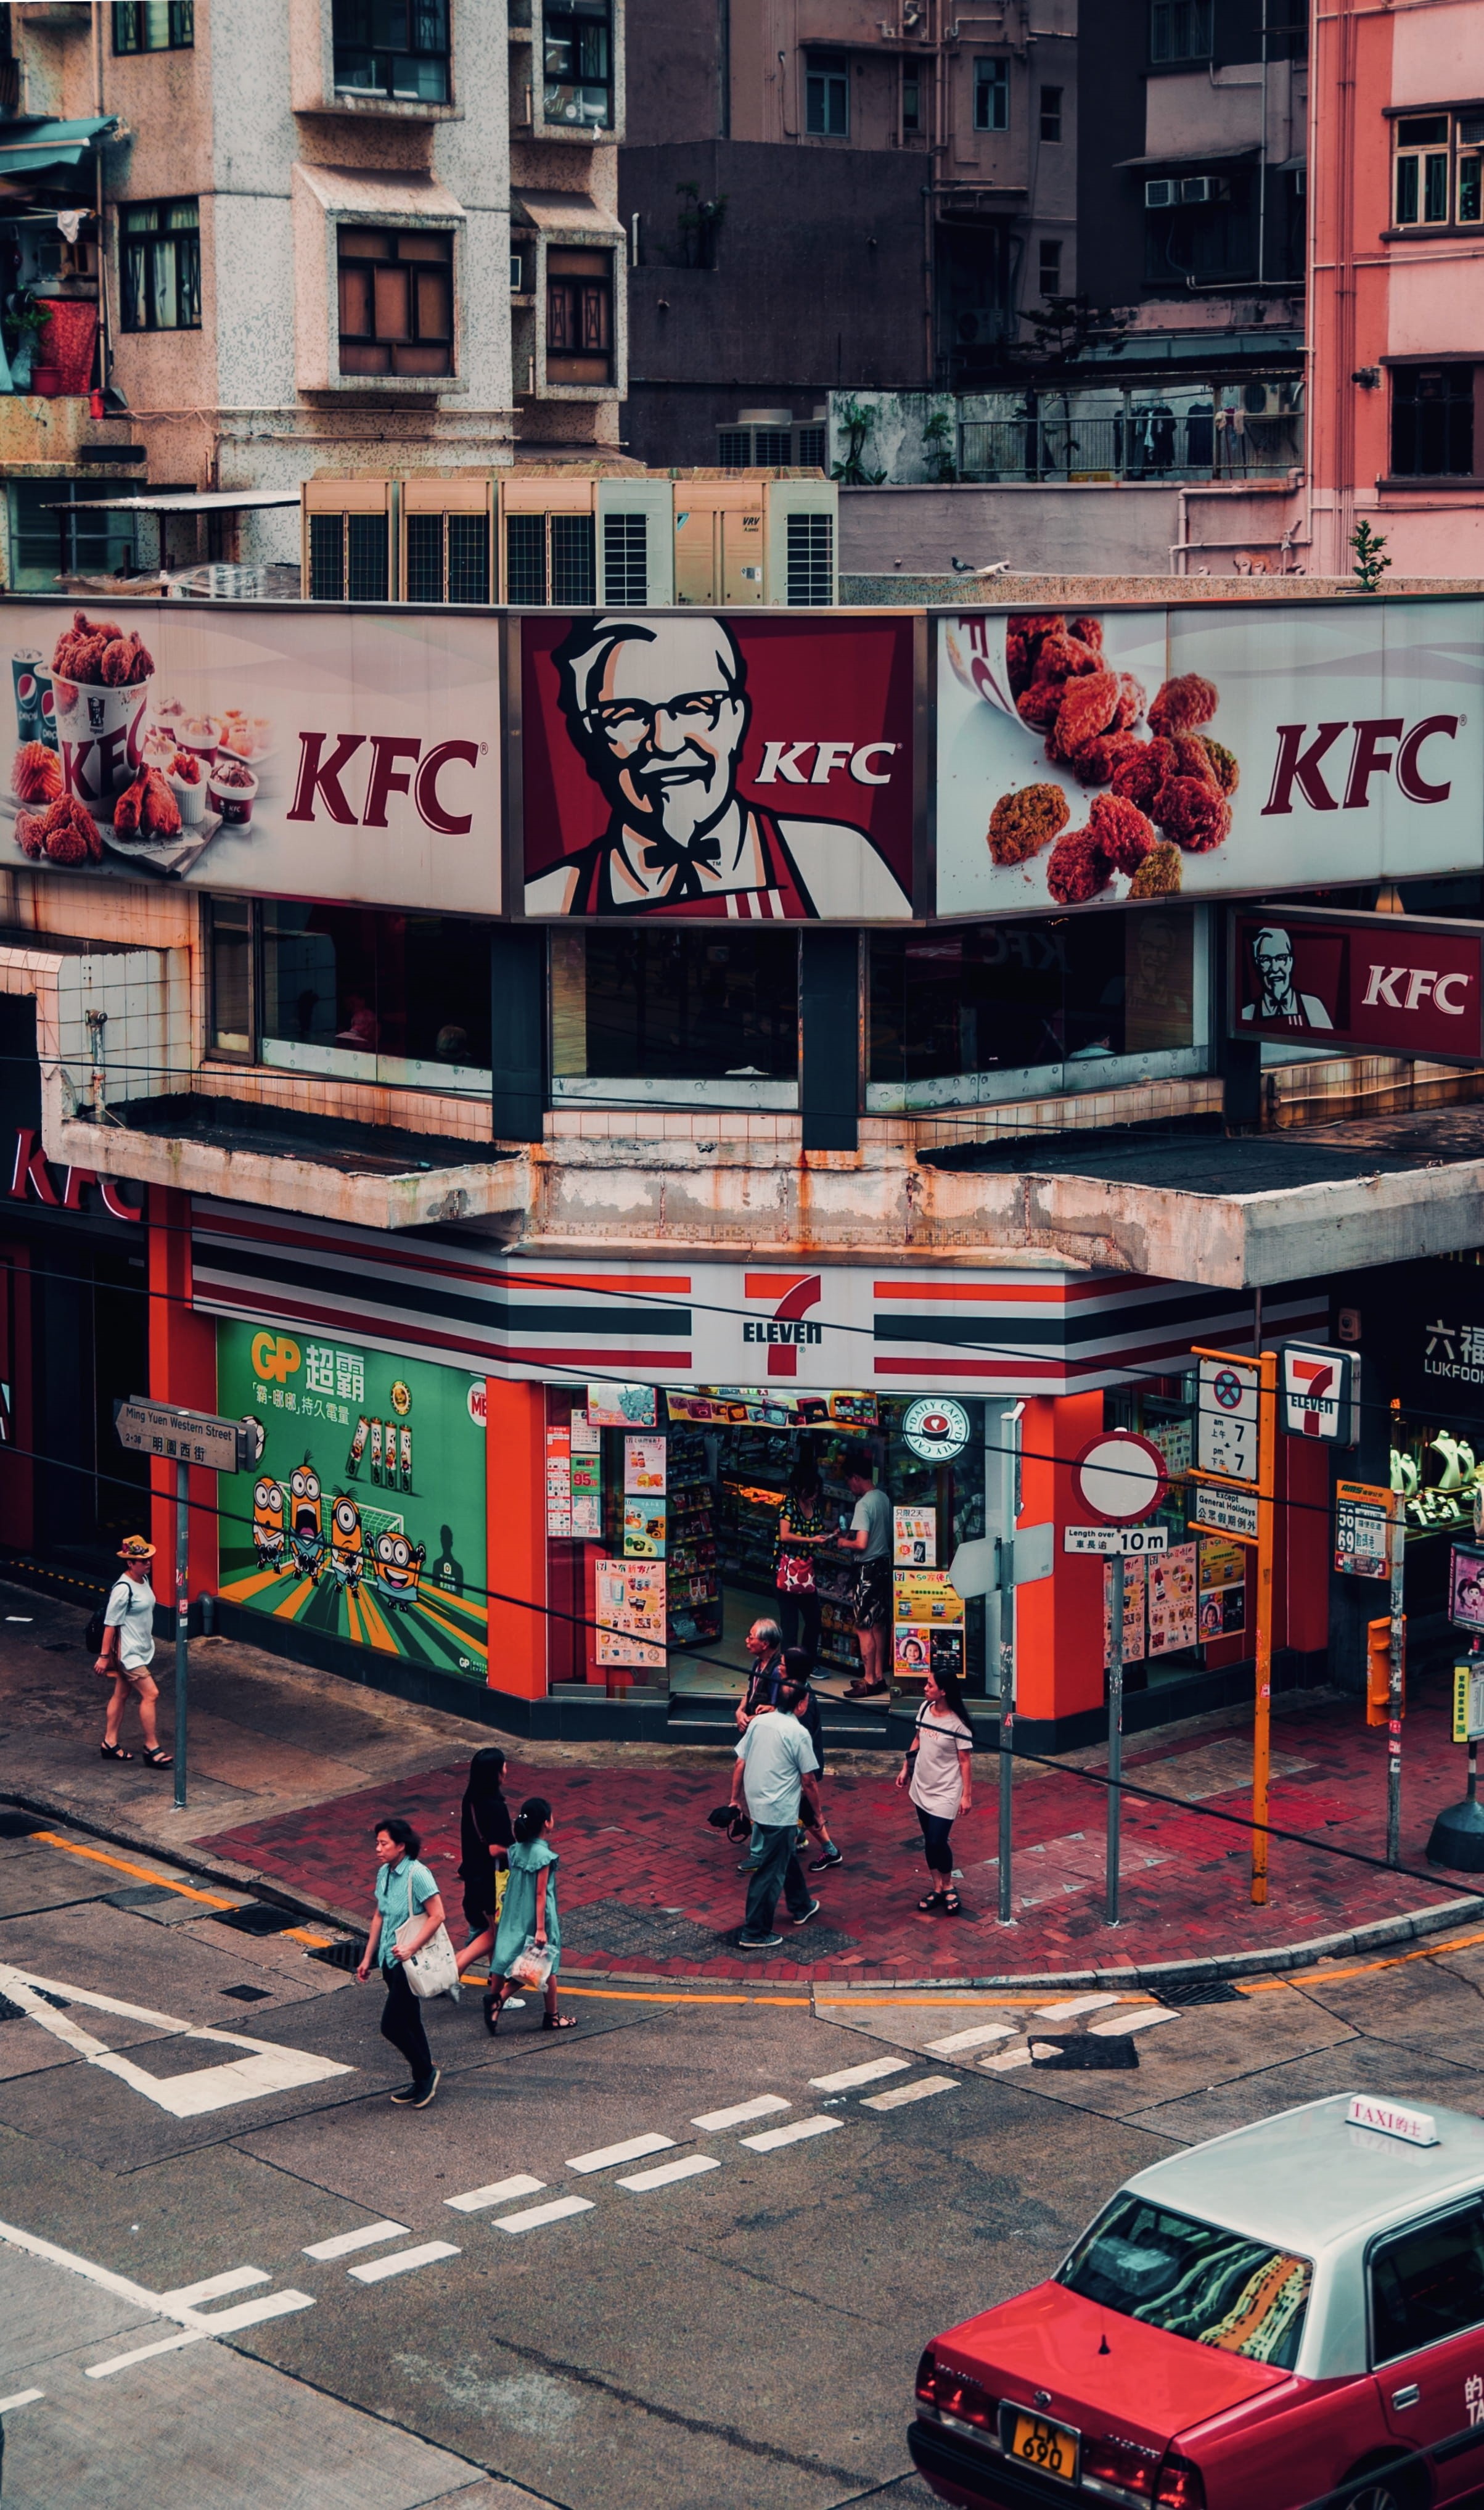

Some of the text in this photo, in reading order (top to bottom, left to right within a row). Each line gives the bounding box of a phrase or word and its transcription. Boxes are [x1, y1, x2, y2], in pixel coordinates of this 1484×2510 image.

[742, 516, 760, 525] VRV
[42, 728, 59, 740] pep
[753, 741, 896, 785] KFC
[1260, 715, 1459, 816] KFC
[287, 731, 479, 835] KFC
[1361, 965, 1469, 1015] KFC
[744, 1273, 821, 1376] 7
[252, 1331, 365, 1404] GP 超霸
[1293, 1359, 1333, 1436] 7
[126, 1407, 232, 1441] Ming Yuen Western Street
[910, 1401, 936, 1425] DAILY
[1211, 1428, 1226, 1439] 上午
[1213, 1418, 1244, 1442] am 7
[152, 1436, 205, 1462] 明園西街
[911, 1435, 932, 1454] CAF
[1211, 1457, 1226, 1466] 下午
[1213, 1447, 1244, 1471] pm 7
[573, 1473, 591, 1487] 95
[1199, 1495, 1256, 1516] General Holidays
[1216, 1492, 1239, 1503] Except
[1198, 1507, 1256, 1531] 公眾假期例外
[1068, 1529, 1096, 1538] Length
[1121, 1533, 1144, 1550] 10
[1147, 1535, 1163, 1549] m
[1075, 1540, 1107, 1550] 車長逾
[1338, 1529, 1354, 1552] 69
[459, 1656, 470, 1668] GP
[1351, 2101, 1421, 2137] TAXI 的士
[1022, 2437, 1063, 2472] 690
